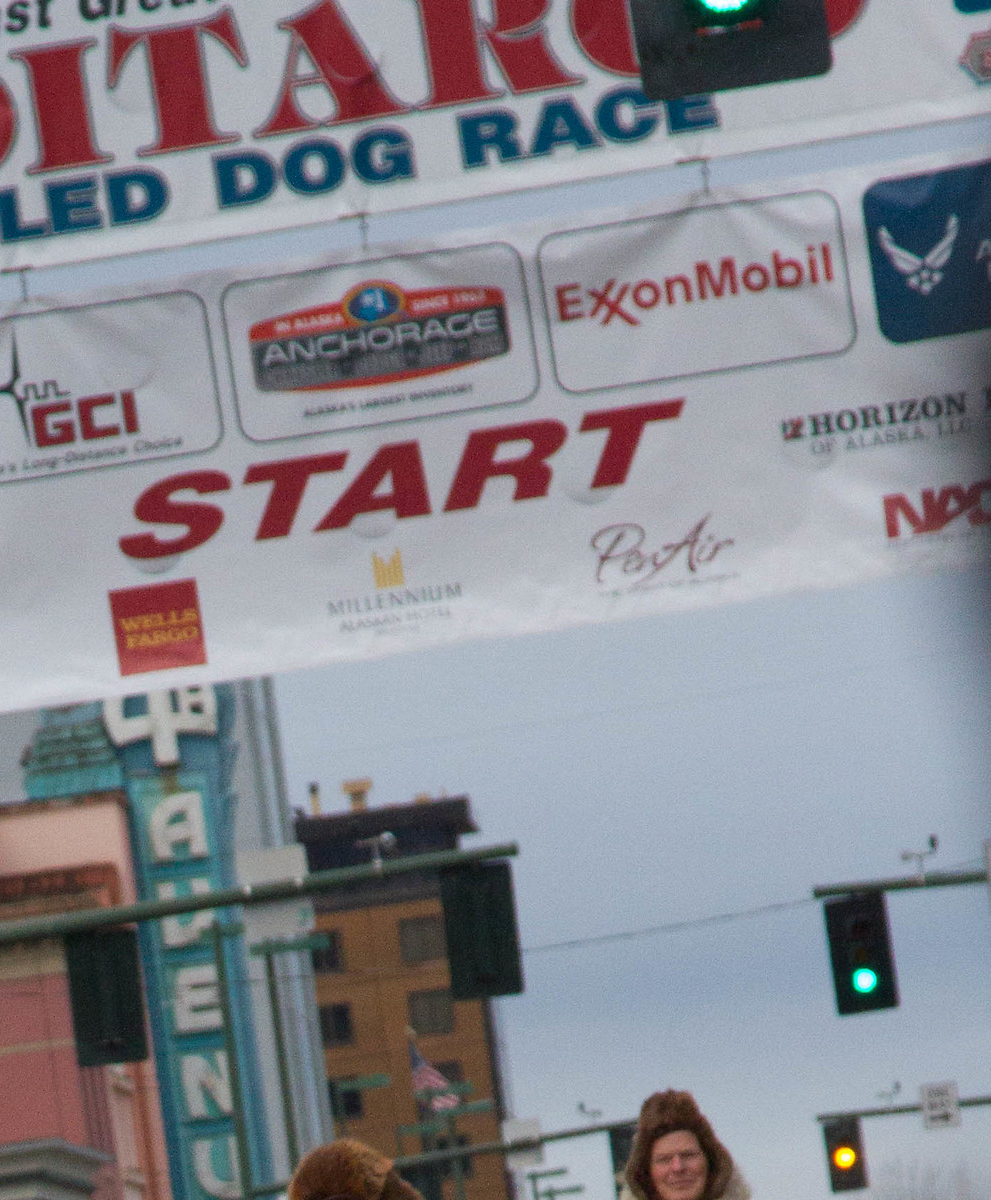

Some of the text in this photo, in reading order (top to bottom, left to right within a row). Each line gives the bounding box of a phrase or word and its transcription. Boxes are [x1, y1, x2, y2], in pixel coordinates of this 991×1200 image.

[214, 126, 416, 211] DOG
[456, 82, 721, 172] RACE
[554, 242, 835, 328] ExxonMobil
[262, 308, 500, 368] ANCHORAGE
[31, 388, 141, 449] GCI
[808, 391, 968, 437] HORIZON
[118, 399, 686, 563] START
[121, 606, 199, 632] WELLS
[325, 580, 463, 618] MILLENNIUM
[126, 624, 201, 650] FARGO
